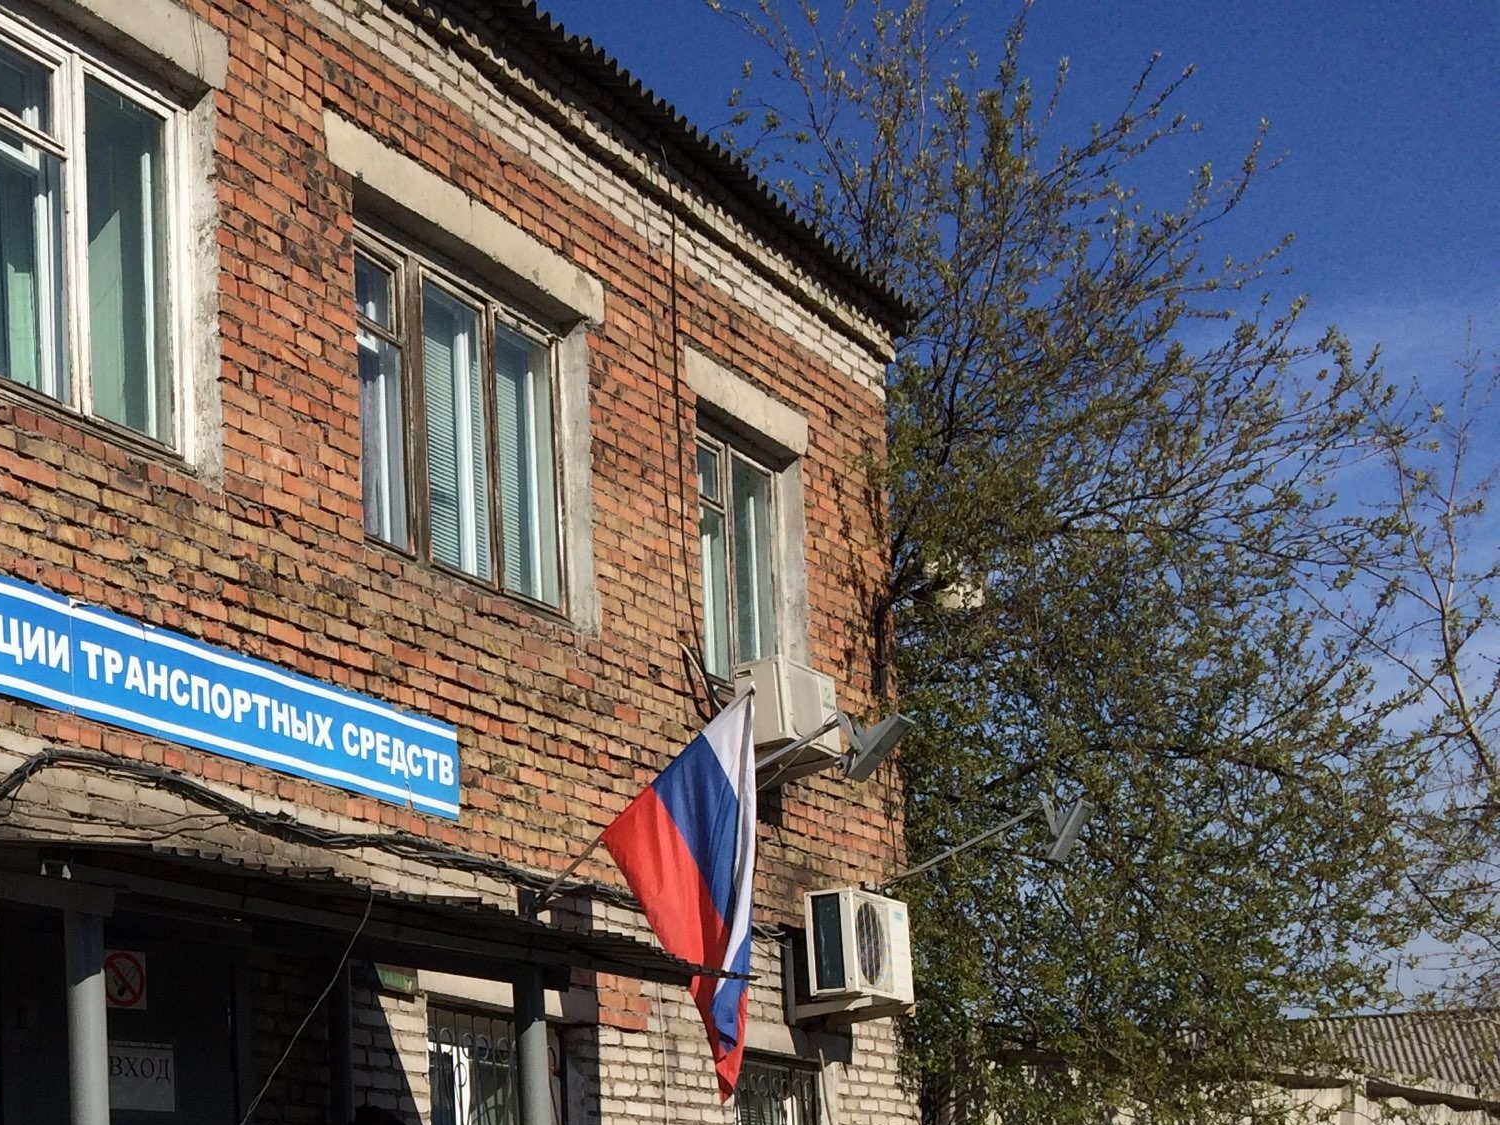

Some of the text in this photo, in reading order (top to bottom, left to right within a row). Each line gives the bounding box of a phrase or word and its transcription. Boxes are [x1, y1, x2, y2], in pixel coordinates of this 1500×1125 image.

[80, 640, 335, 751] ТРАНСПОРТНЫХ
[342, 721, 455, 786] СРЕДСТВ
[109, 1056, 171, 1084] ВХОД
